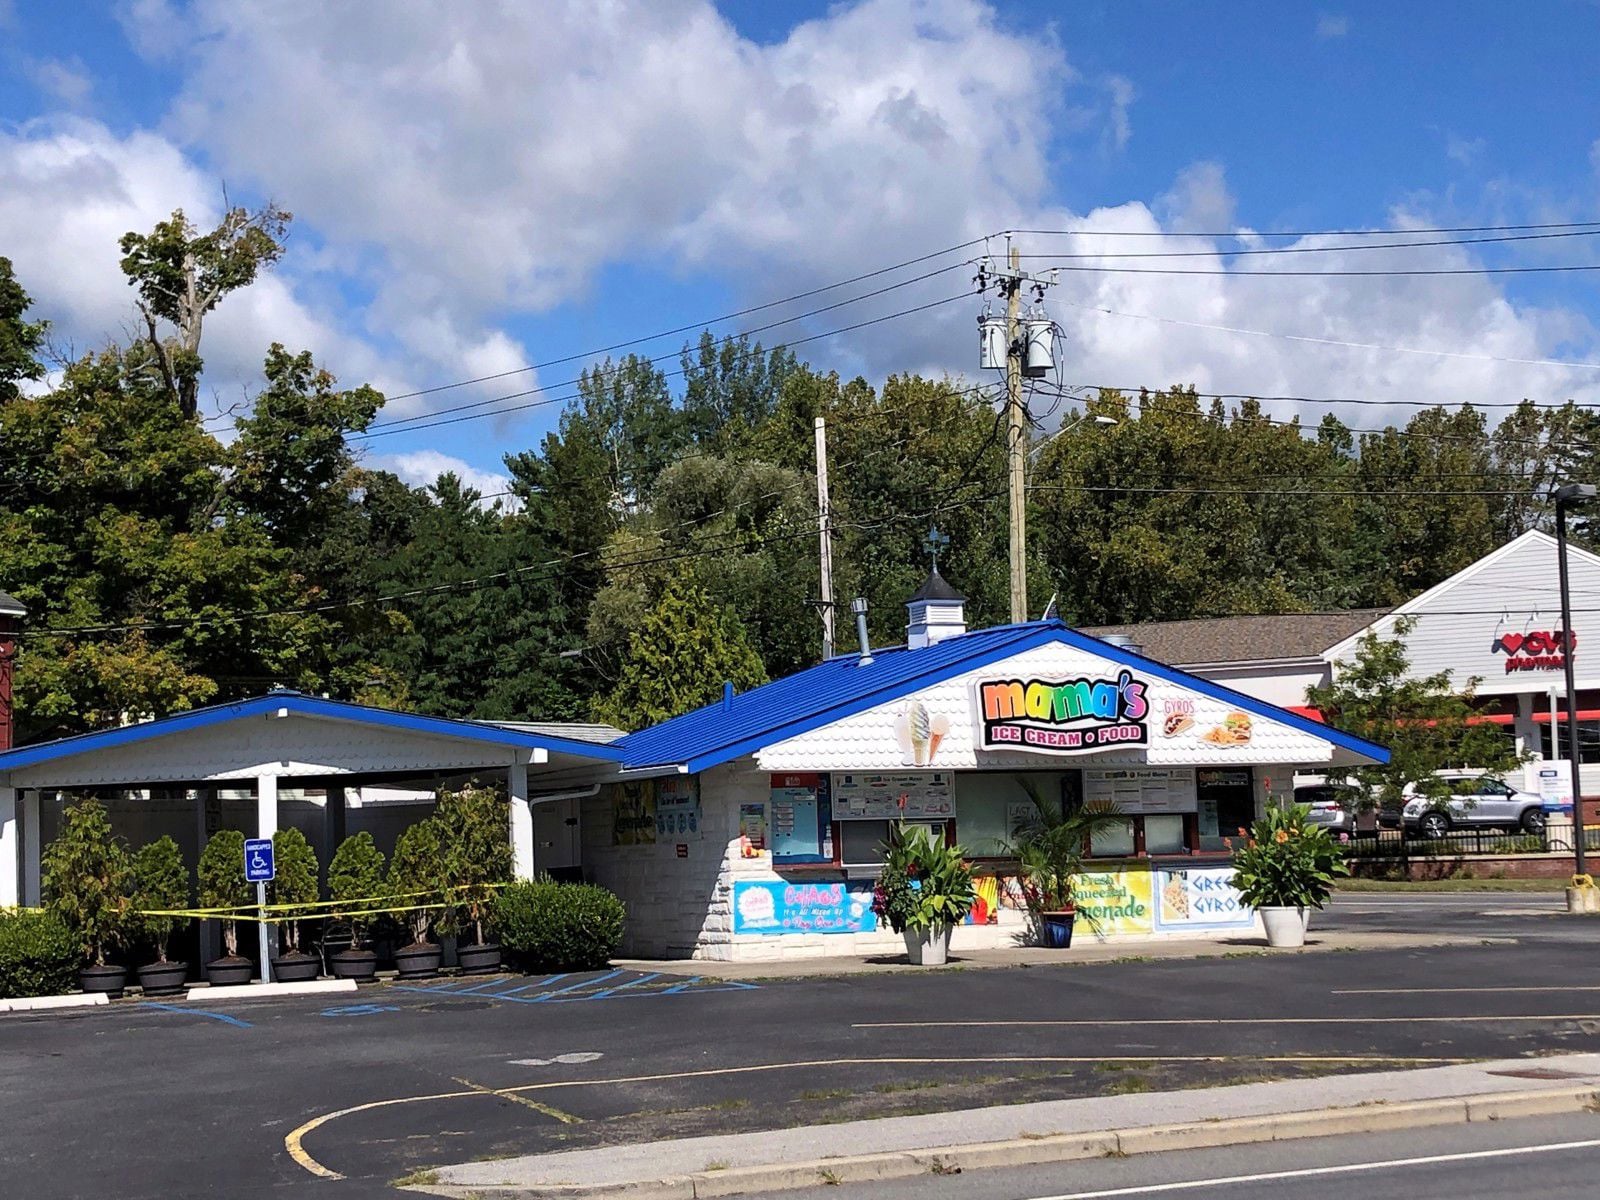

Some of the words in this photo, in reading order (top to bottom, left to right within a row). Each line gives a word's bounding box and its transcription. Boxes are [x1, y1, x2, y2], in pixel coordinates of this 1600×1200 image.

[982, 672, 1149, 722] mama's
[1164, 700, 1195, 713] GYROS
[992, 726, 1020, 741] ICE
[1025, 728, 1082, 746] CREAM
[1099, 726, 1141, 743] FOOD
[1081, 874, 1114, 885] Fresh
[1193, 875, 1233, 892] GREE
[1193, 896, 1236, 913] GYRO
